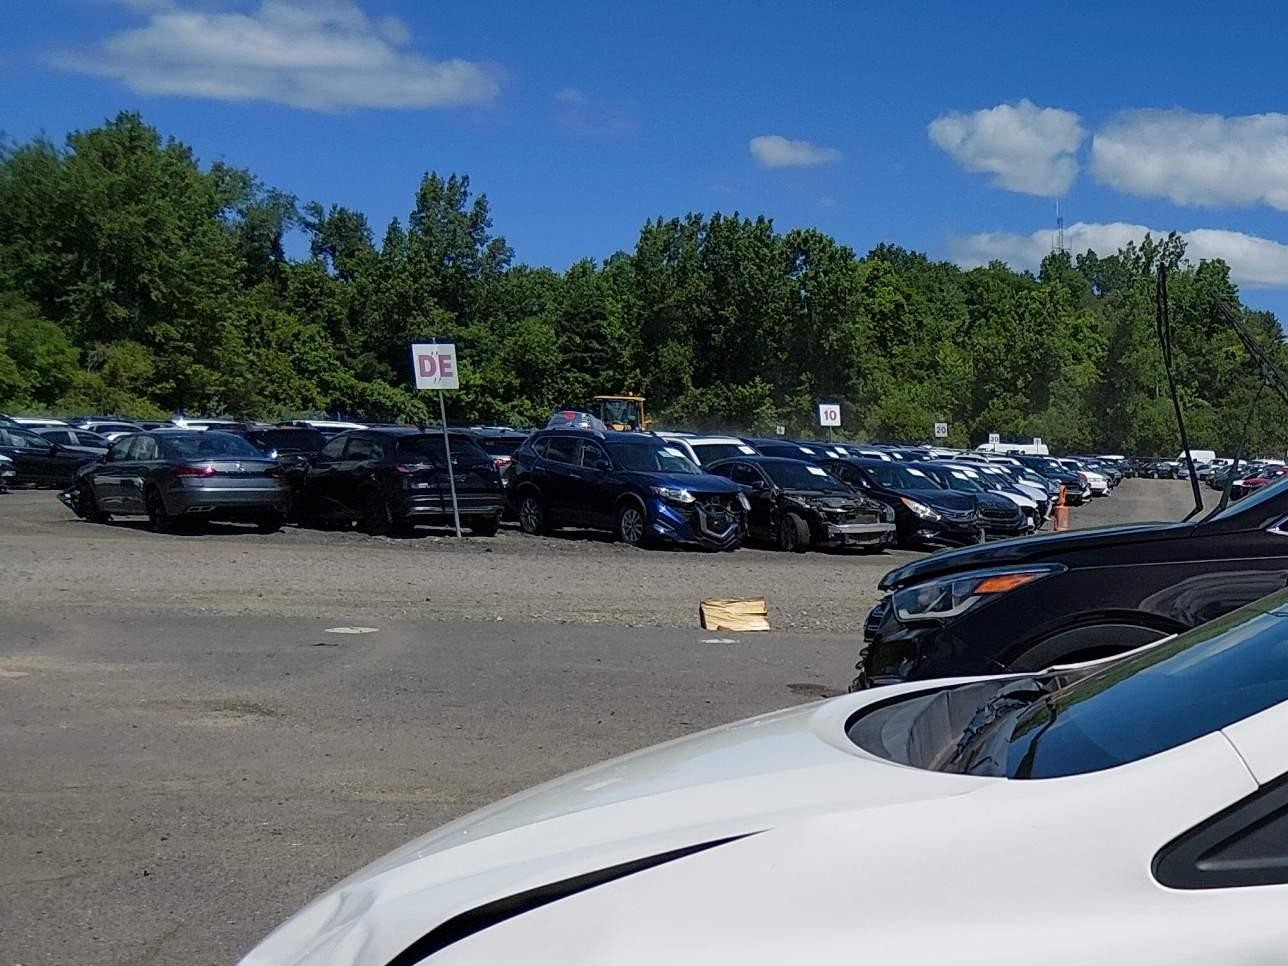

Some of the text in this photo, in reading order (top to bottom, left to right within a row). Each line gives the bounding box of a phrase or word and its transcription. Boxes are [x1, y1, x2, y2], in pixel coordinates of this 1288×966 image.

[418, 354, 454, 378] DE
[823, 409, 837, 421] 10
[936, 426, 947, 434] 20
